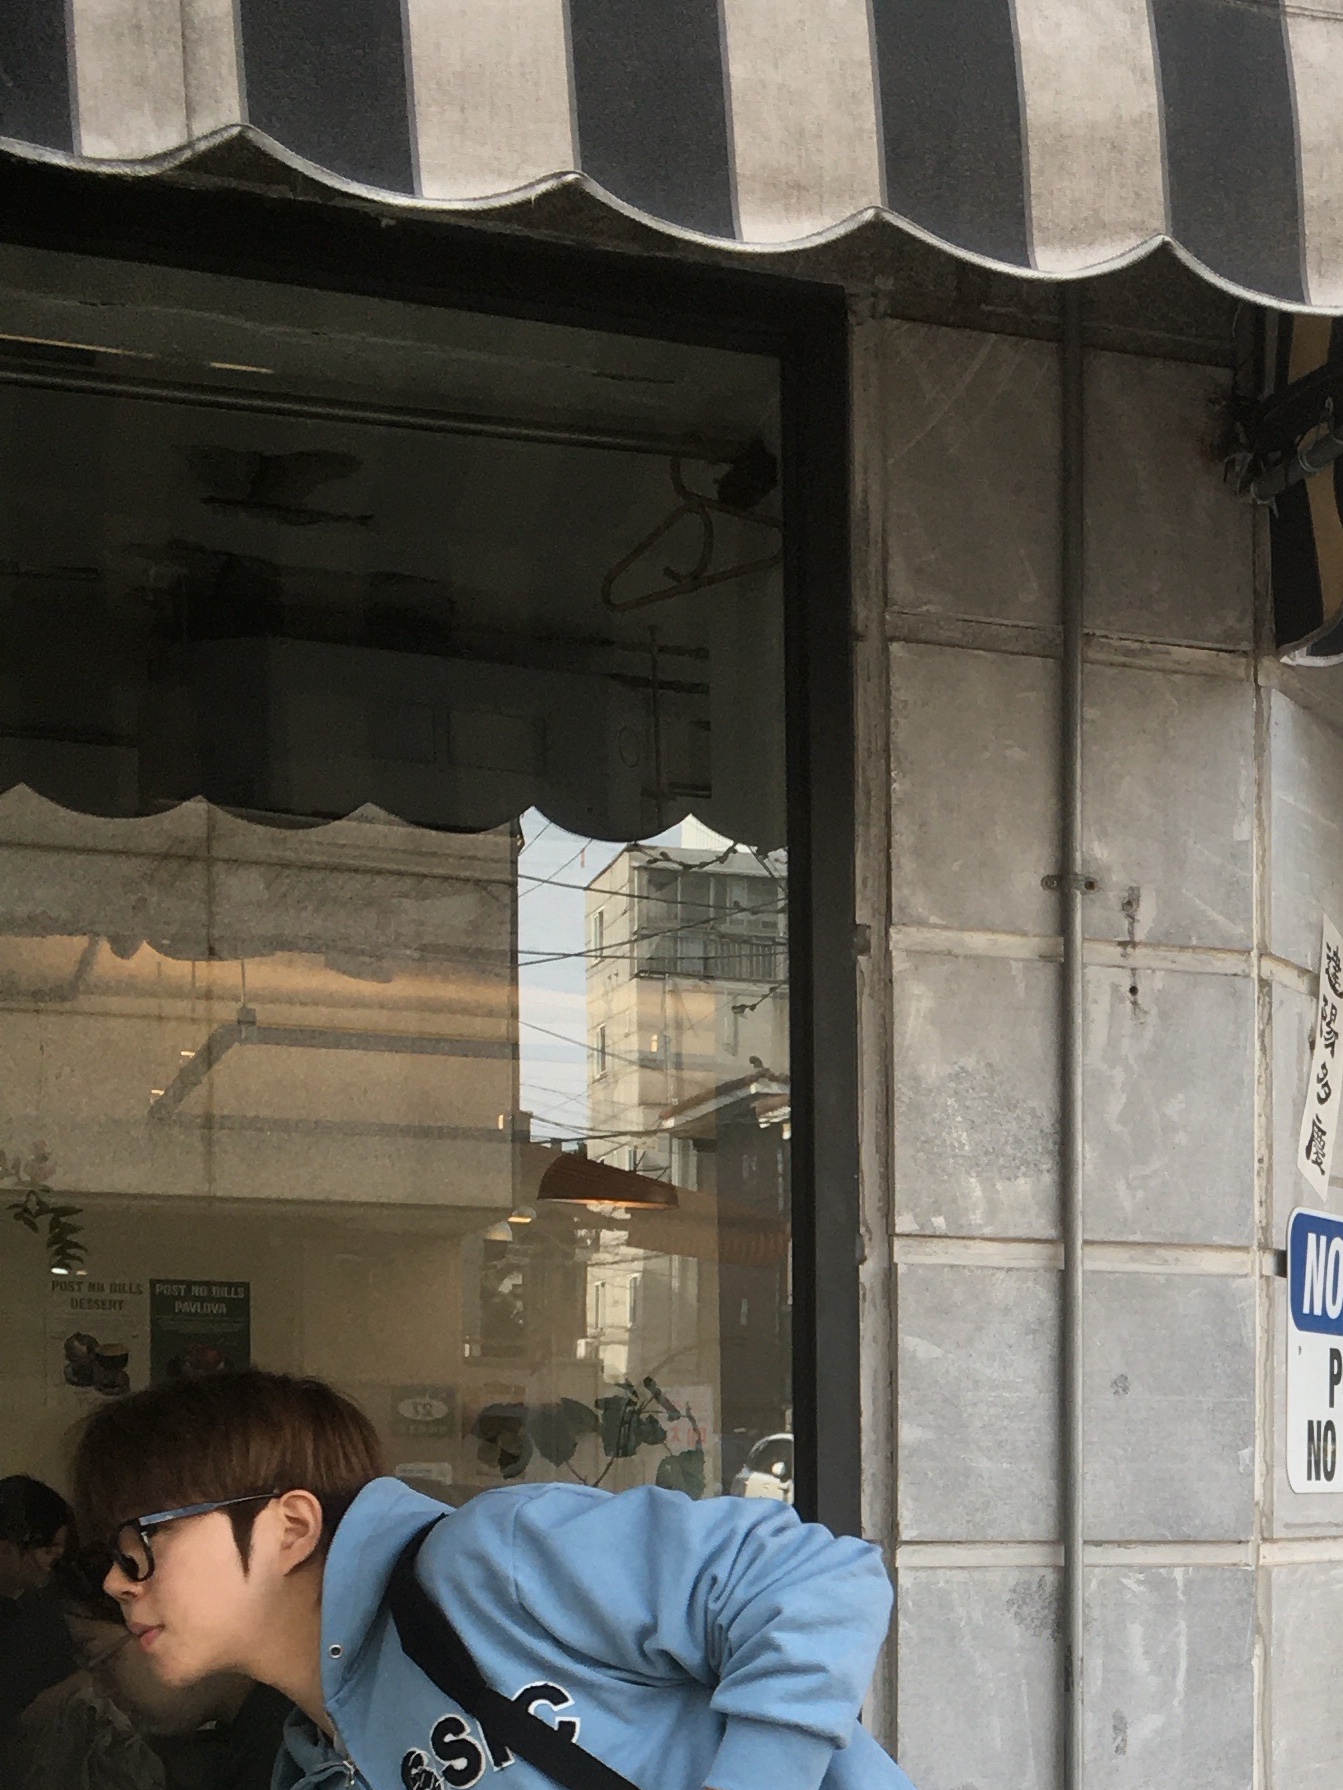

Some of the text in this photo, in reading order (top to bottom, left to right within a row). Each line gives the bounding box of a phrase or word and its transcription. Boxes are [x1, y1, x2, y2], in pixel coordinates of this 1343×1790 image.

[51, 1280, 84, 1293] POST
[155, 1283, 187, 1296] POST
[70, 1297, 124, 1311] DESSERT
[1306, 1419, 1334, 1481] NO
